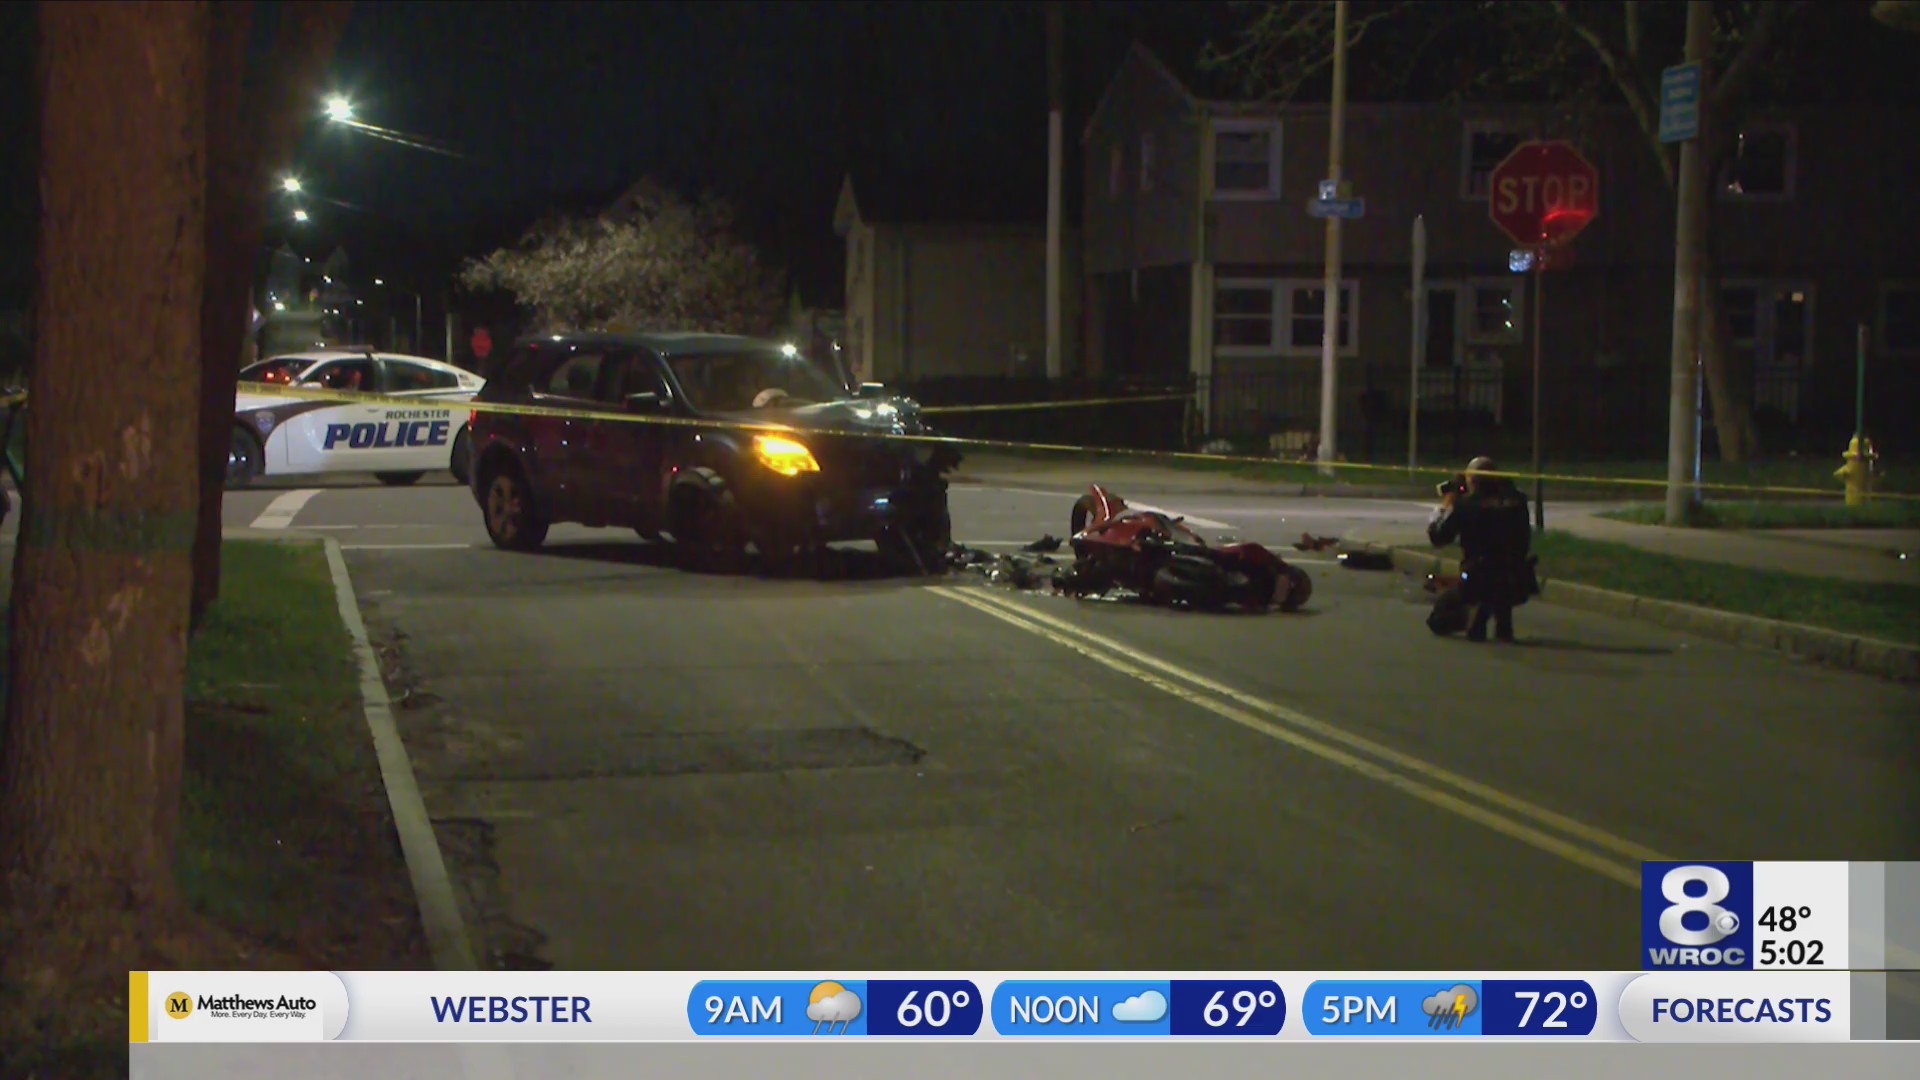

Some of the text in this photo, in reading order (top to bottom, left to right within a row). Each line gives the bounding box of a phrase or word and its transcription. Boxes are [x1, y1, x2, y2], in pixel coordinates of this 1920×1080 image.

[1496, 173, 1590, 215] STOP
[385, 409, 450, 420] ROCHESTER
[323, 420, 450, 451] POLICE
